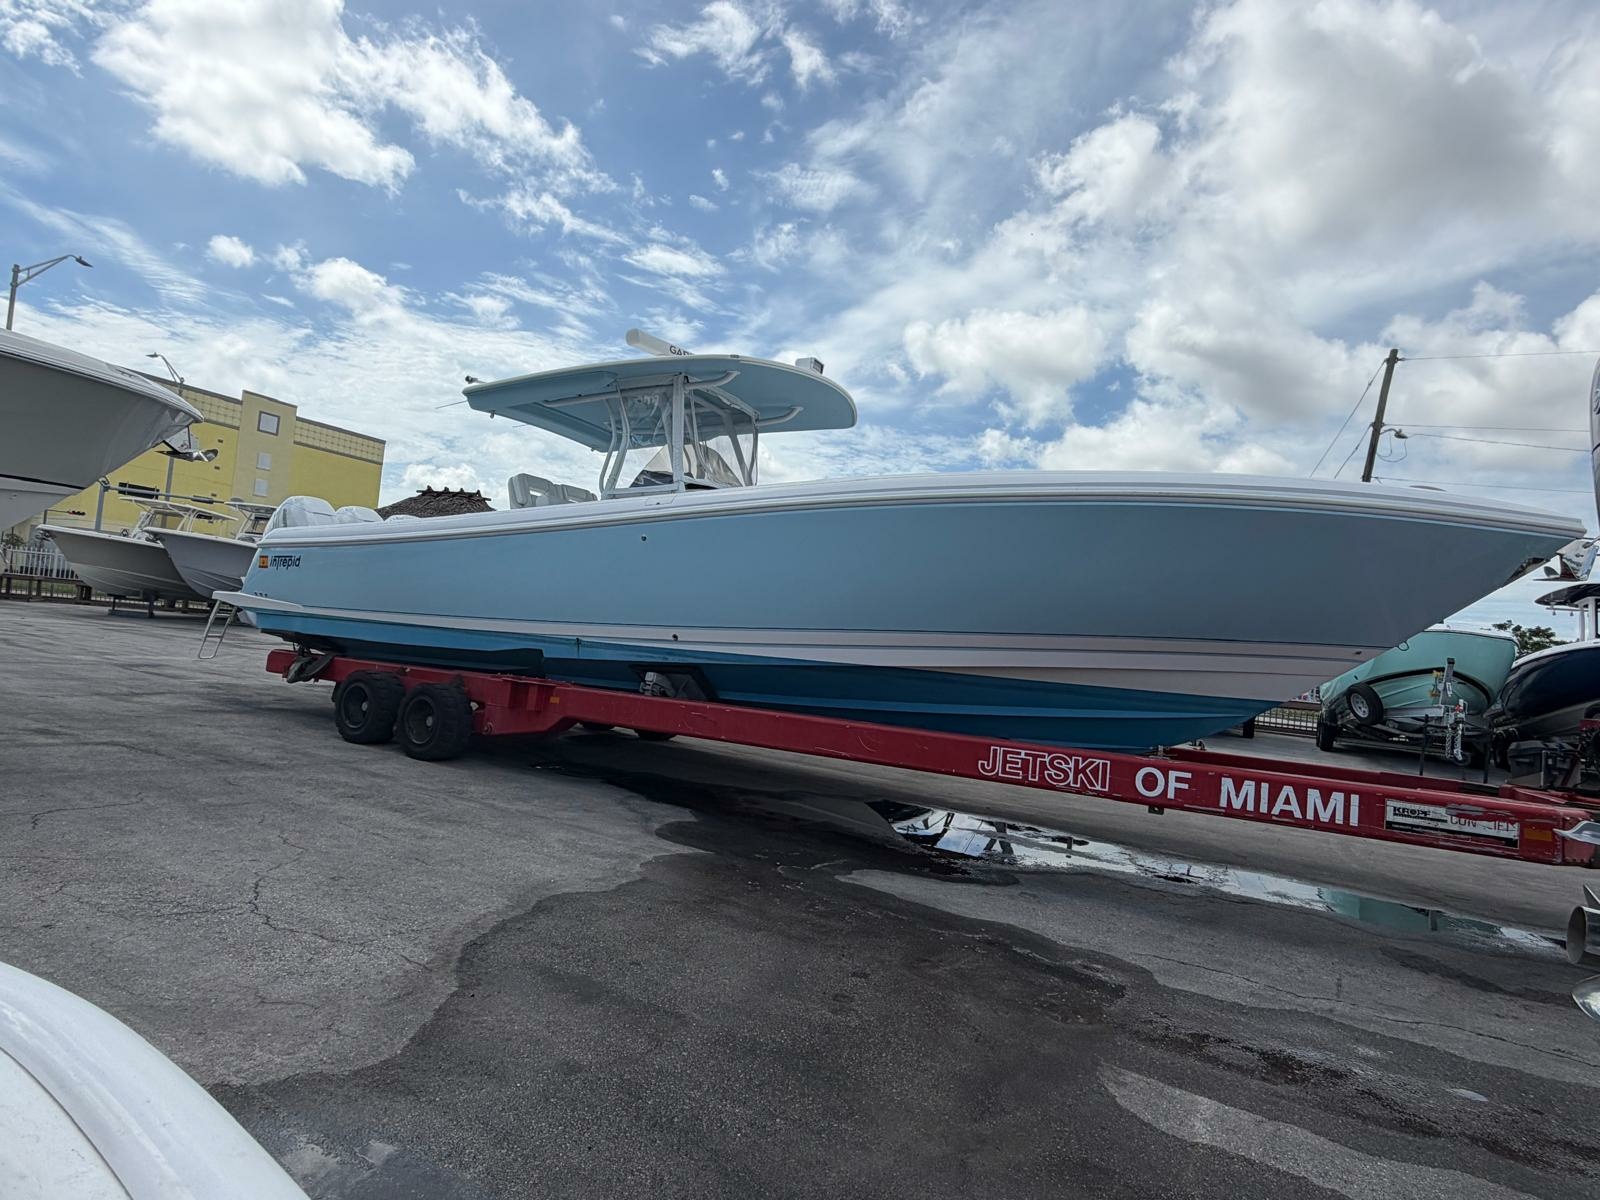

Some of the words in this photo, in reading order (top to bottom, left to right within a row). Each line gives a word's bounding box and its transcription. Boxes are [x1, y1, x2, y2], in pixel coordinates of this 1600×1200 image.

[978, 746, 1110, 792] JETSKI
[1135, 766, 1192, 799] OF
[1220, 777, 1360, 827] MIAMI
[1393, 806, 1431, 817] KROPF
